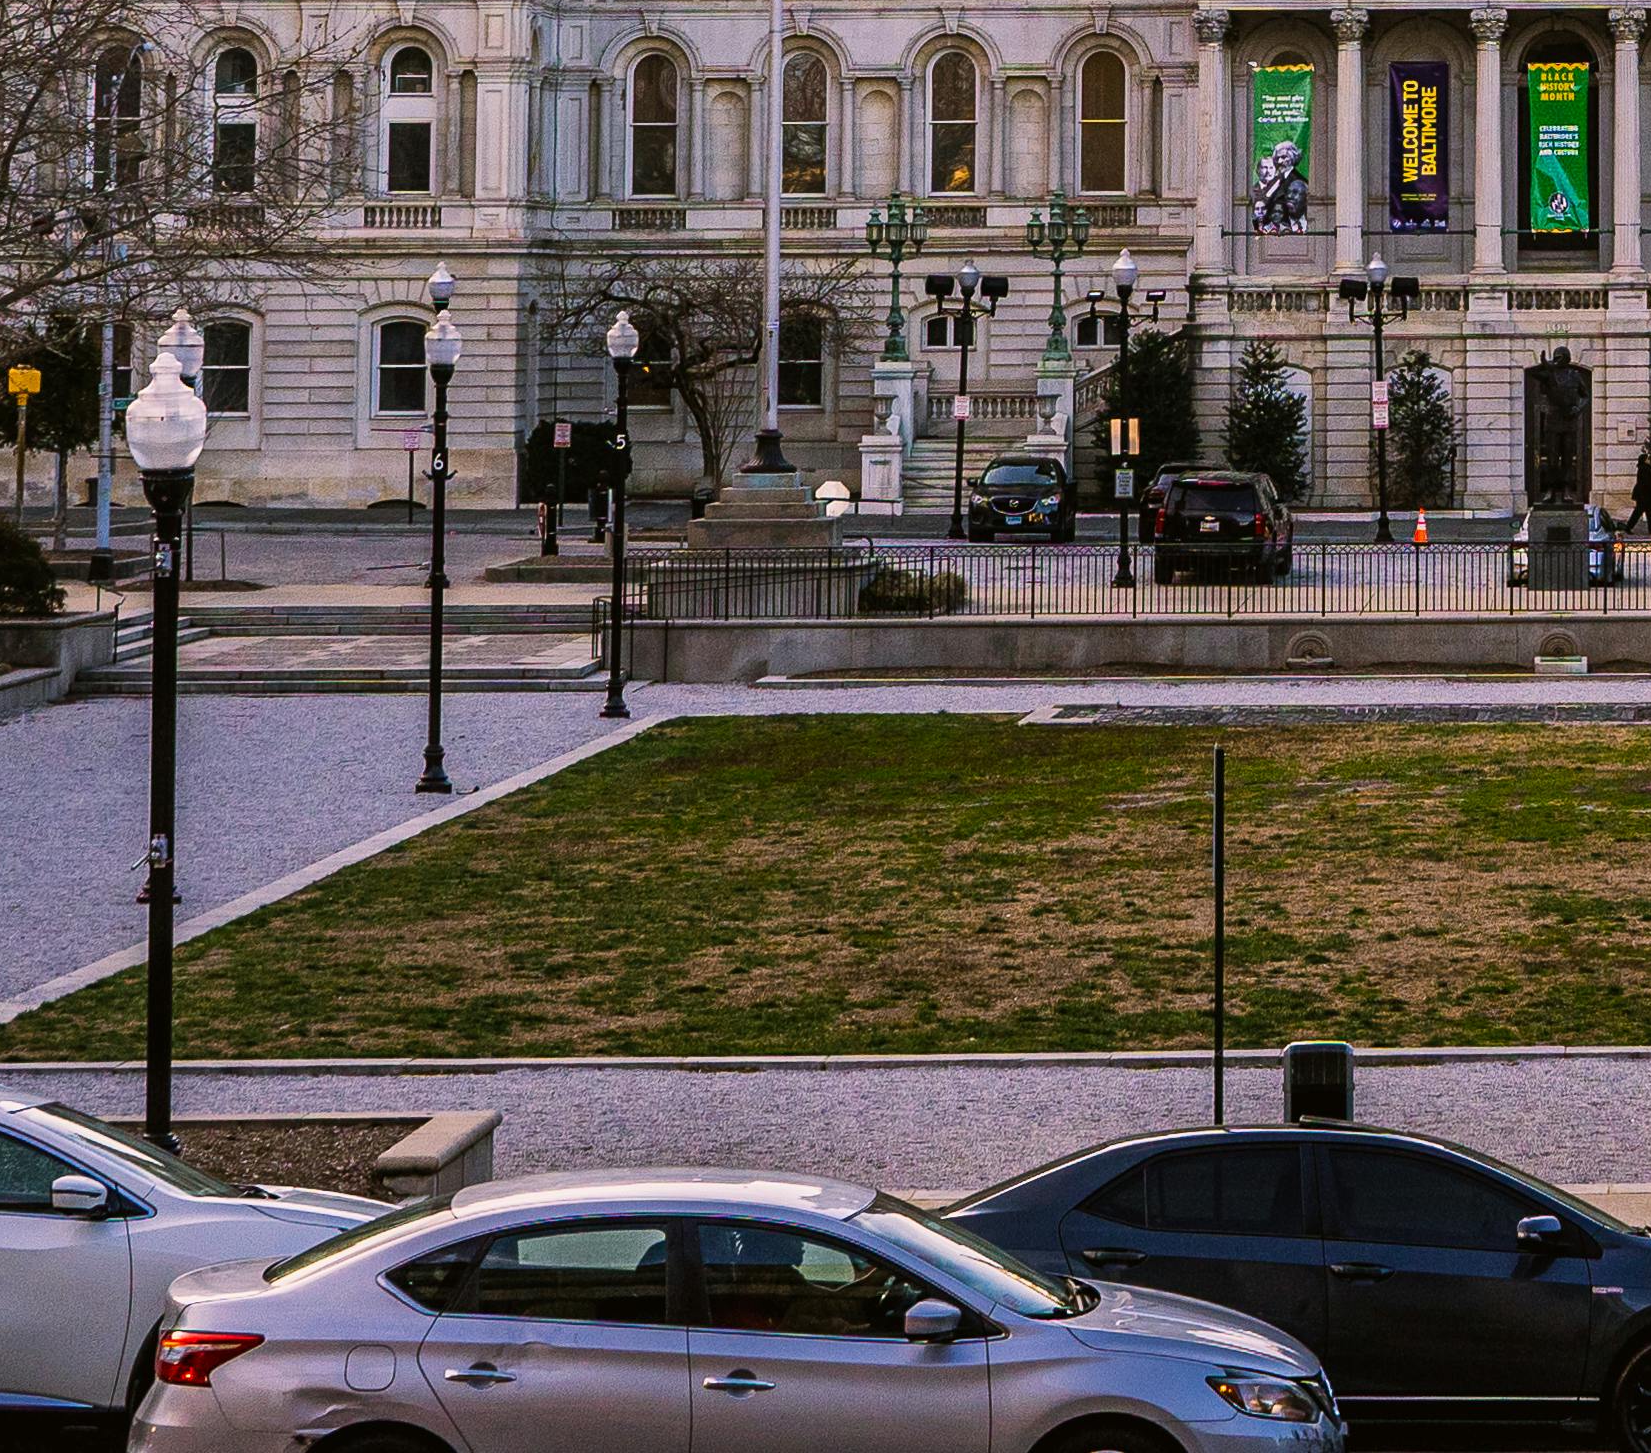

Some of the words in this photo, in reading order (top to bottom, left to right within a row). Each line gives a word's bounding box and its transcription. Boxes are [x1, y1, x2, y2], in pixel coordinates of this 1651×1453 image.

[1540, 72, 1574, 81] BLACK
[1402, 80, 1419, 102] TO
[1539, 82, 1575, 92] HISTORY
[1539, 93, 1575, 101] MONTH
[1421, 85, 1437, 176] BALTIMORE
[1402, 103, 1419, 183] WELCOME
[616, 434, 626, 450] 5
[433, 453, 444, 470] 6
